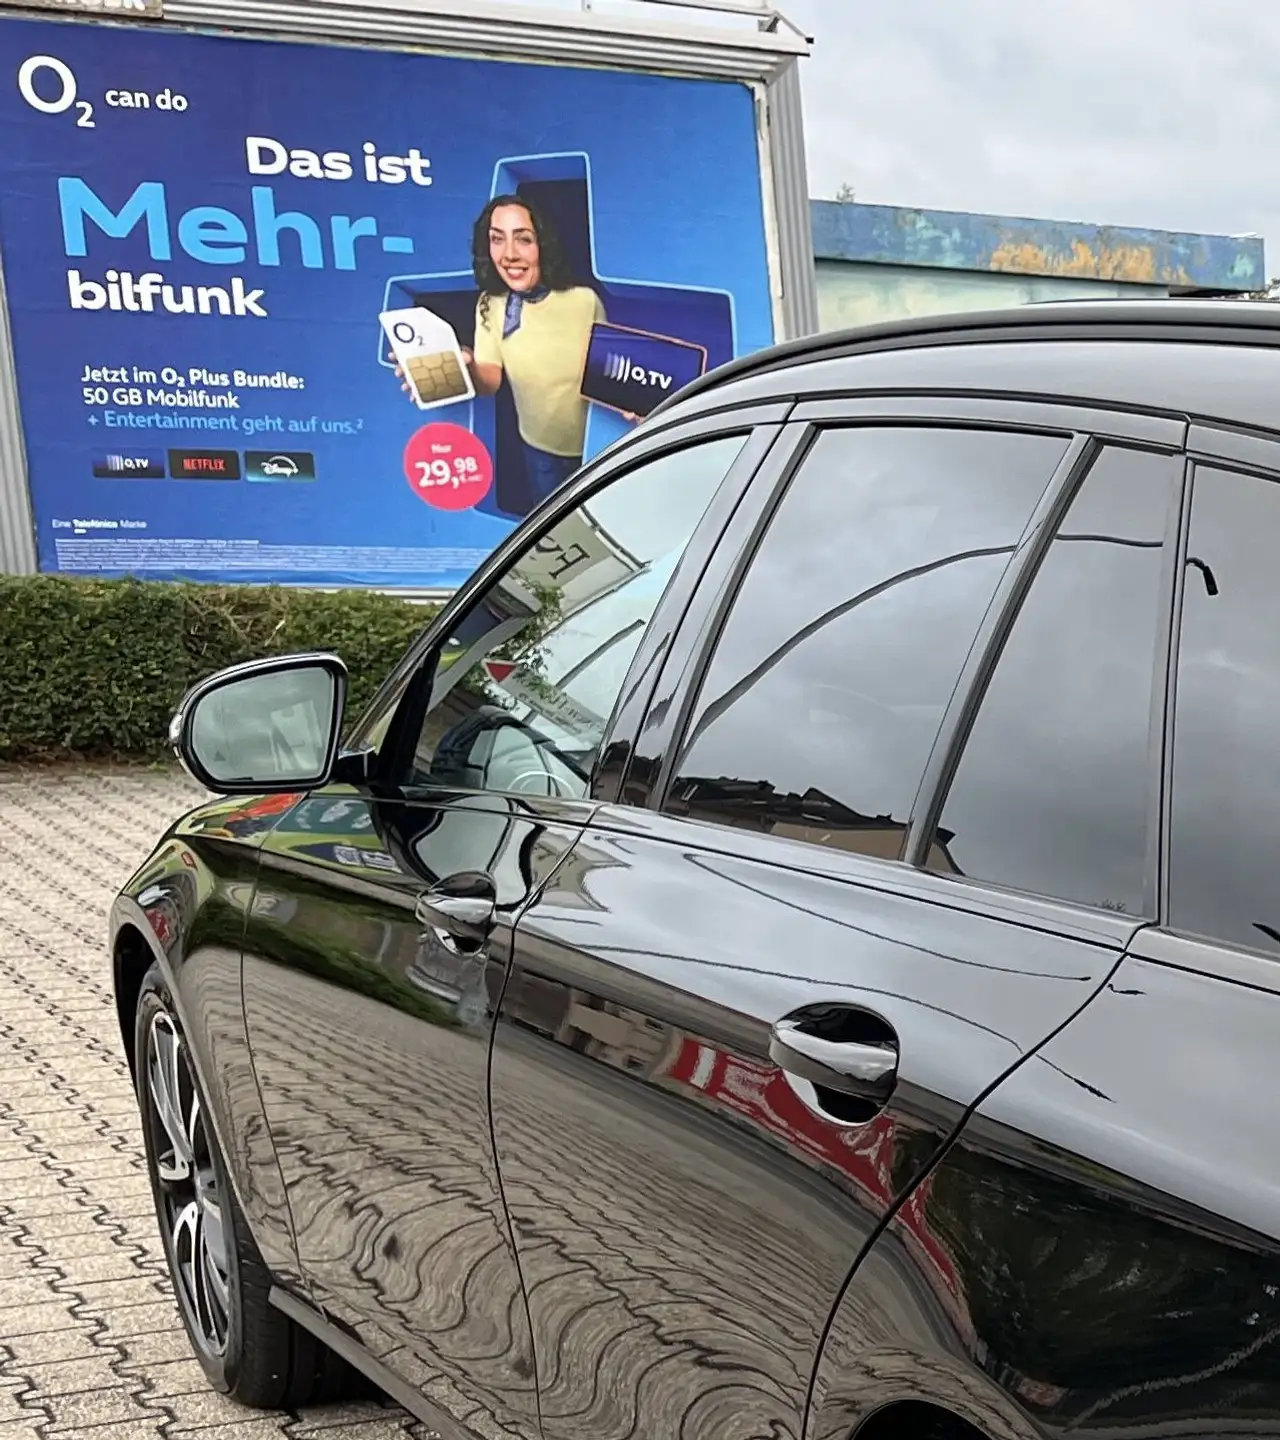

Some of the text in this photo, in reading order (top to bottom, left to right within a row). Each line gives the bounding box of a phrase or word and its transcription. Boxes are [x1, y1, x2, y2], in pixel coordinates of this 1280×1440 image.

[105, 89, 150, 108] can
[155, 88, 188, 111] do
[245, 136, 433, 187] Das ist
[57, 176, 415, 271] Mehr-
[66, 268, 268, 318] bilfunk
[81, 365, 129, 383] Jetzt
[133, 366, 157, 384] im
[188, 368, 230, 386] Plus
[233, 369, 305, 389] Bundle:
[83, 387, 240, 409] 50 GB Mobilfunk
[104, 410, 239, 431] Entertainment
[242, 415, 285, 435] geht
[288, 416, 319, 432] auf
[183, 458, 226, 471] NETFLIX
